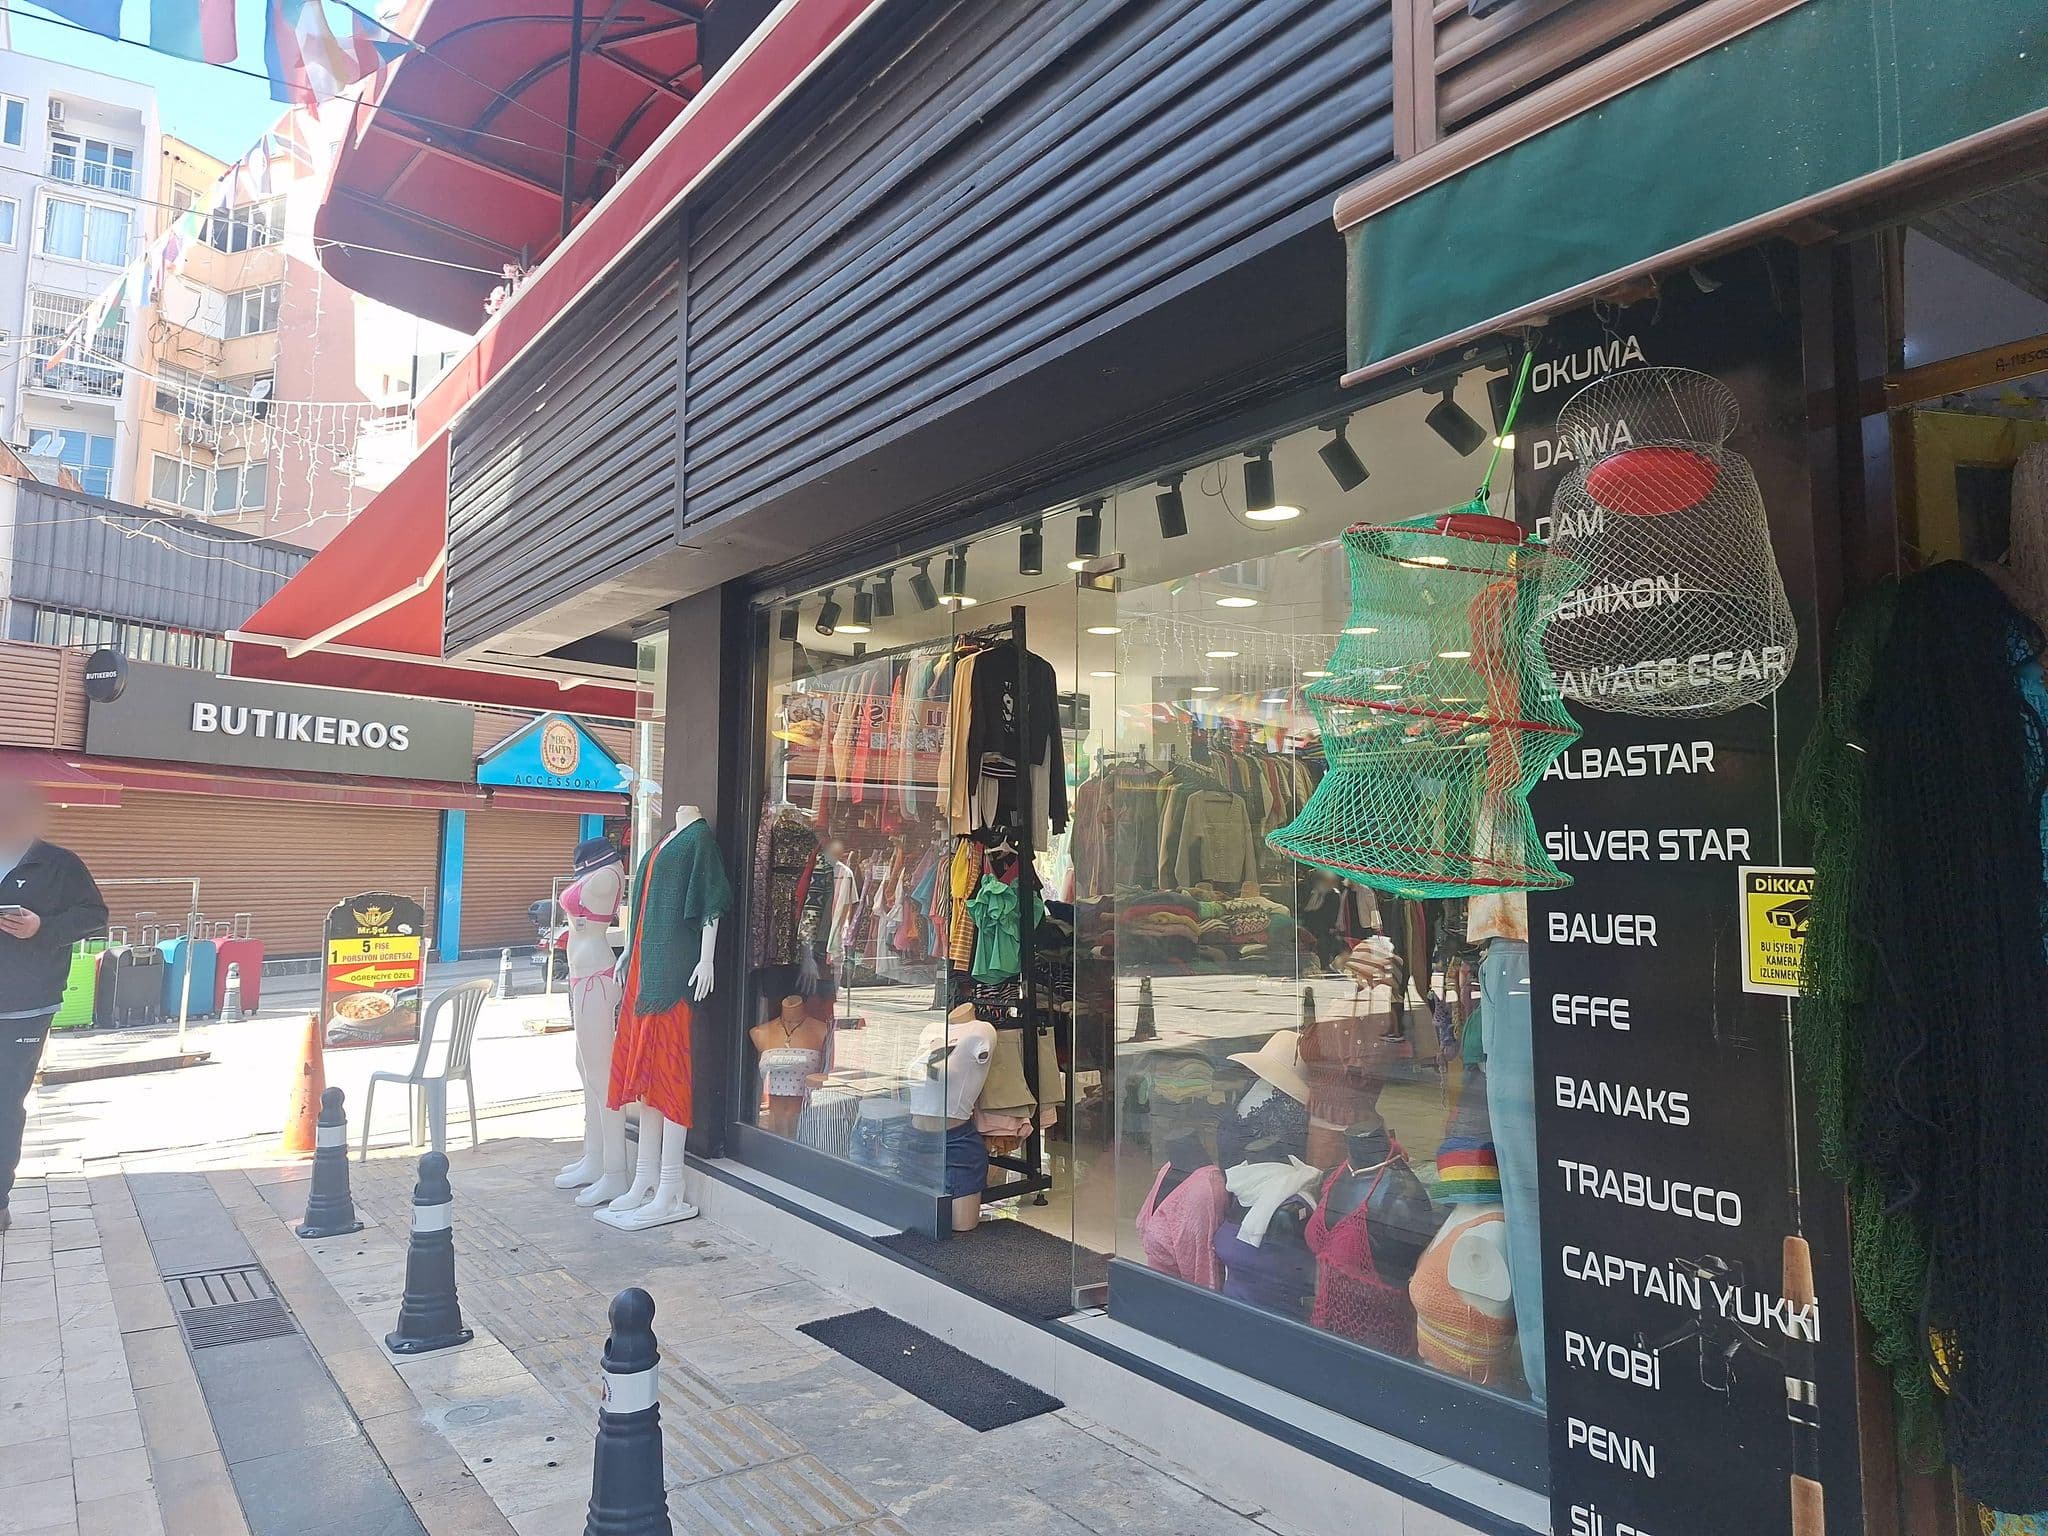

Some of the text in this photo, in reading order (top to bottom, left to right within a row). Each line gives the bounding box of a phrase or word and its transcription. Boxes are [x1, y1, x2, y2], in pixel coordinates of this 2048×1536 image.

[1532, 335, 1645, 393] OKUMA
[1536, 505, 1604, 544] DAM
[1539, 572, 1680, 622] EMİXON
[86, 670, 117, 680] BUTIKEROS
[1688, 645, 1786, 687] GEAR
[192, 702, 409, 751] BUTIKEROS
[1543, 741, 1715, 781] ALBASTAR
[514, 774, 600, 789] ACCESSORY
[1545, 824, 1751, 861] SİLVER STAR
[362, 940, 371, 953] 5
[1549, 912, 1658, 947] BAUER
[1761, 942, 1771, 953] BU
[331, 950, 338, 963] 1
[1766, 955, 1798, 968] KAMERA
[1552, 994, 1630, 1031] EFFE
[1555, 1076, 1690, 1126] BANAKS
[1558, 1159, 1742, 1227] TRABUCCO
[1562, 1245, 1821, 1342] CAPTAİN YUKKİ
[1565, 1330, 1660, 1390] RYOBİ
[1568, 1417, 1655, 1479] PENN
